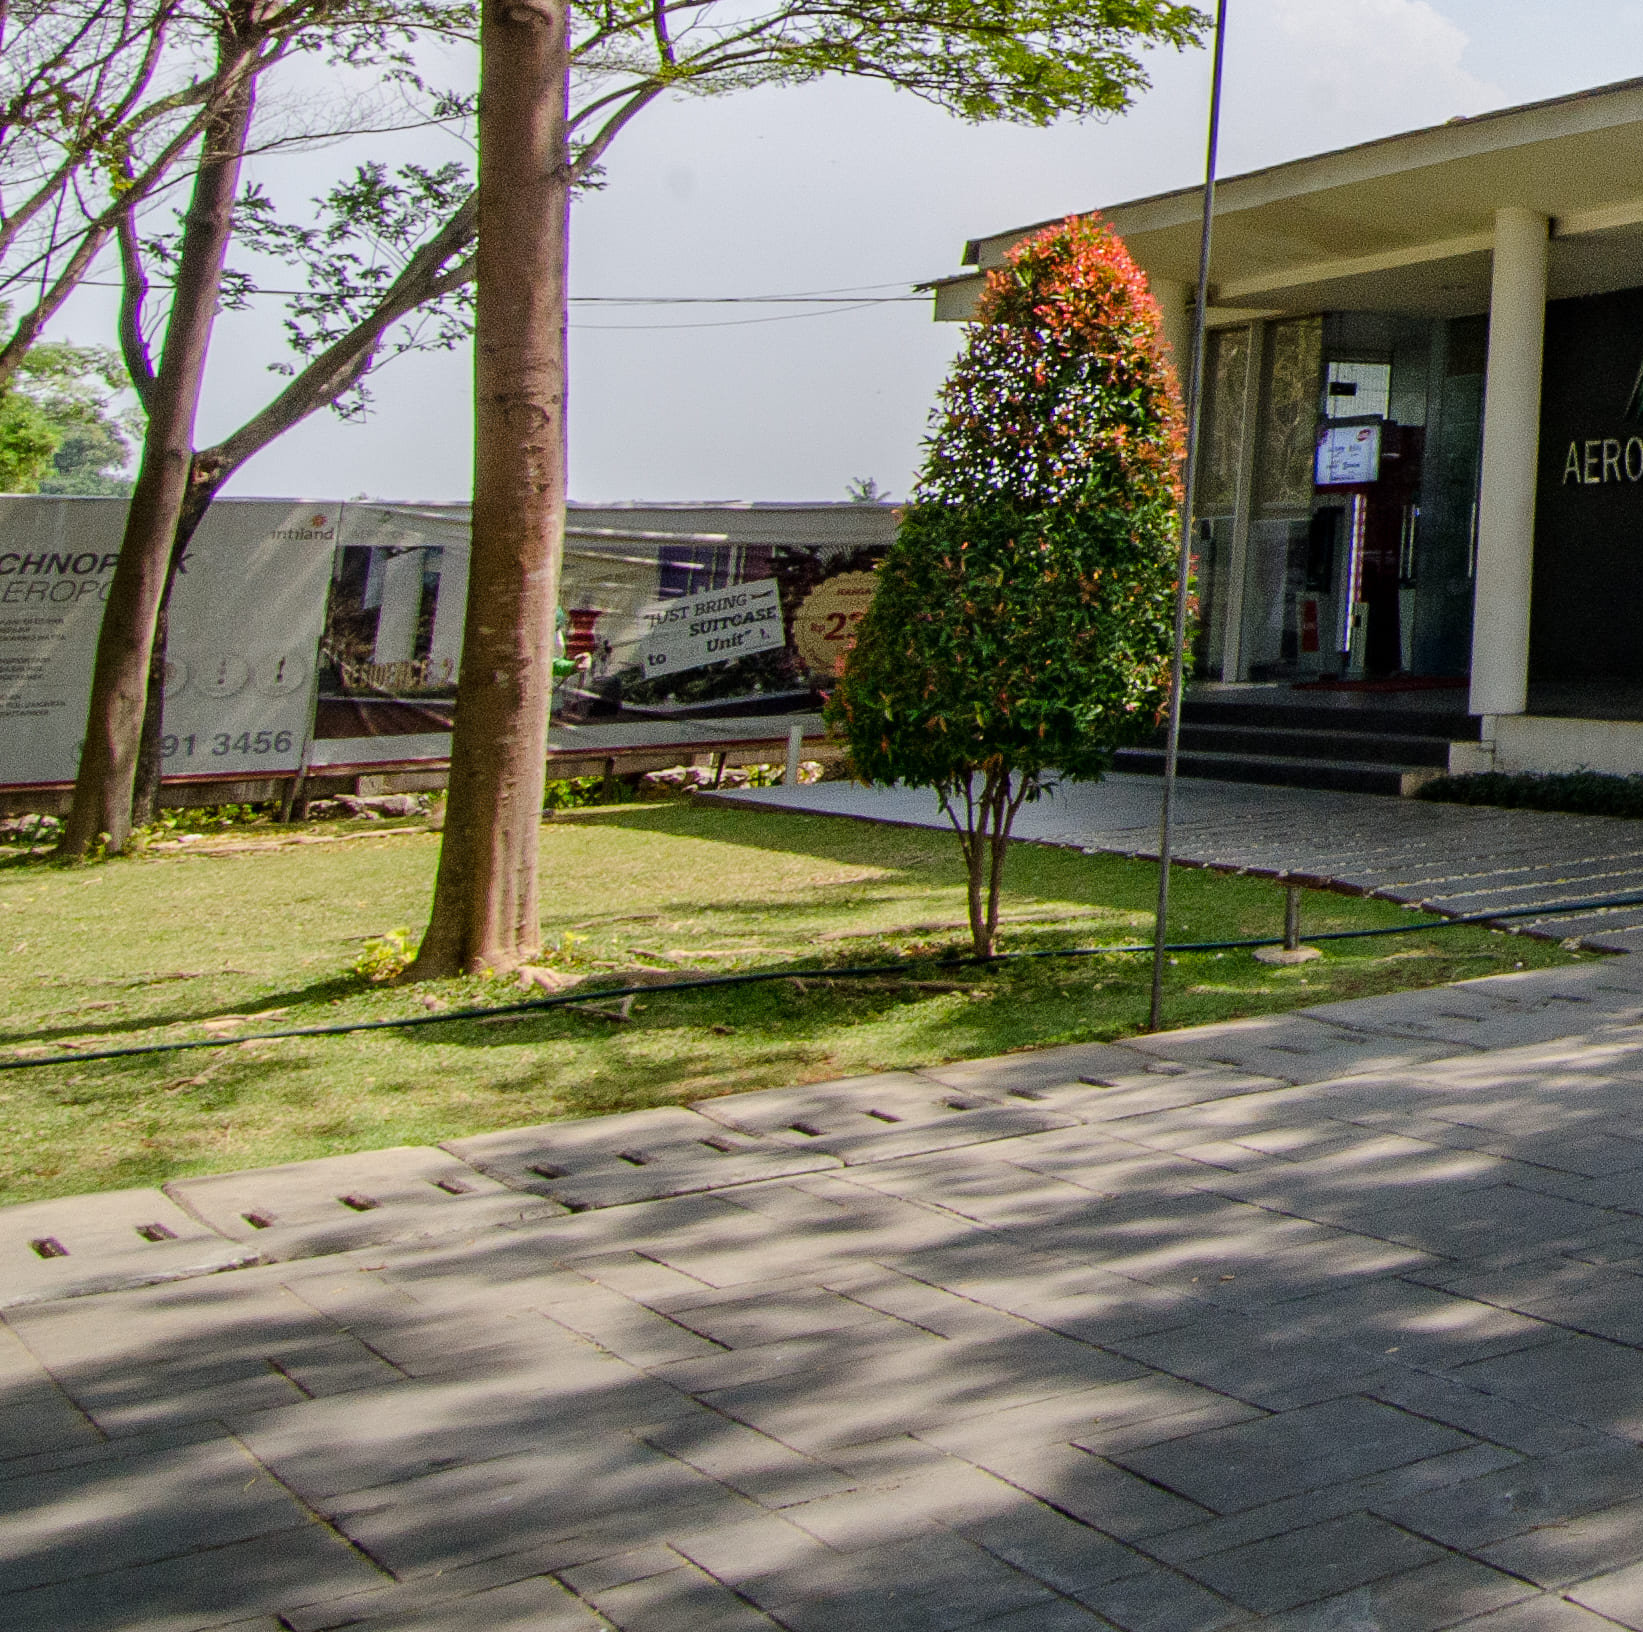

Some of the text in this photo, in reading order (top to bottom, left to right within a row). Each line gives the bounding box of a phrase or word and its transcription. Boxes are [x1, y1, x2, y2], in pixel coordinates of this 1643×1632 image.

[272, 528, 335, 540] intiland
[694, 593, 748, 617] BRING
[689, 605, 778, 637] SUITCASE
[649, 653, 667, 666] to
[211, 730, 293, 756] 3456
